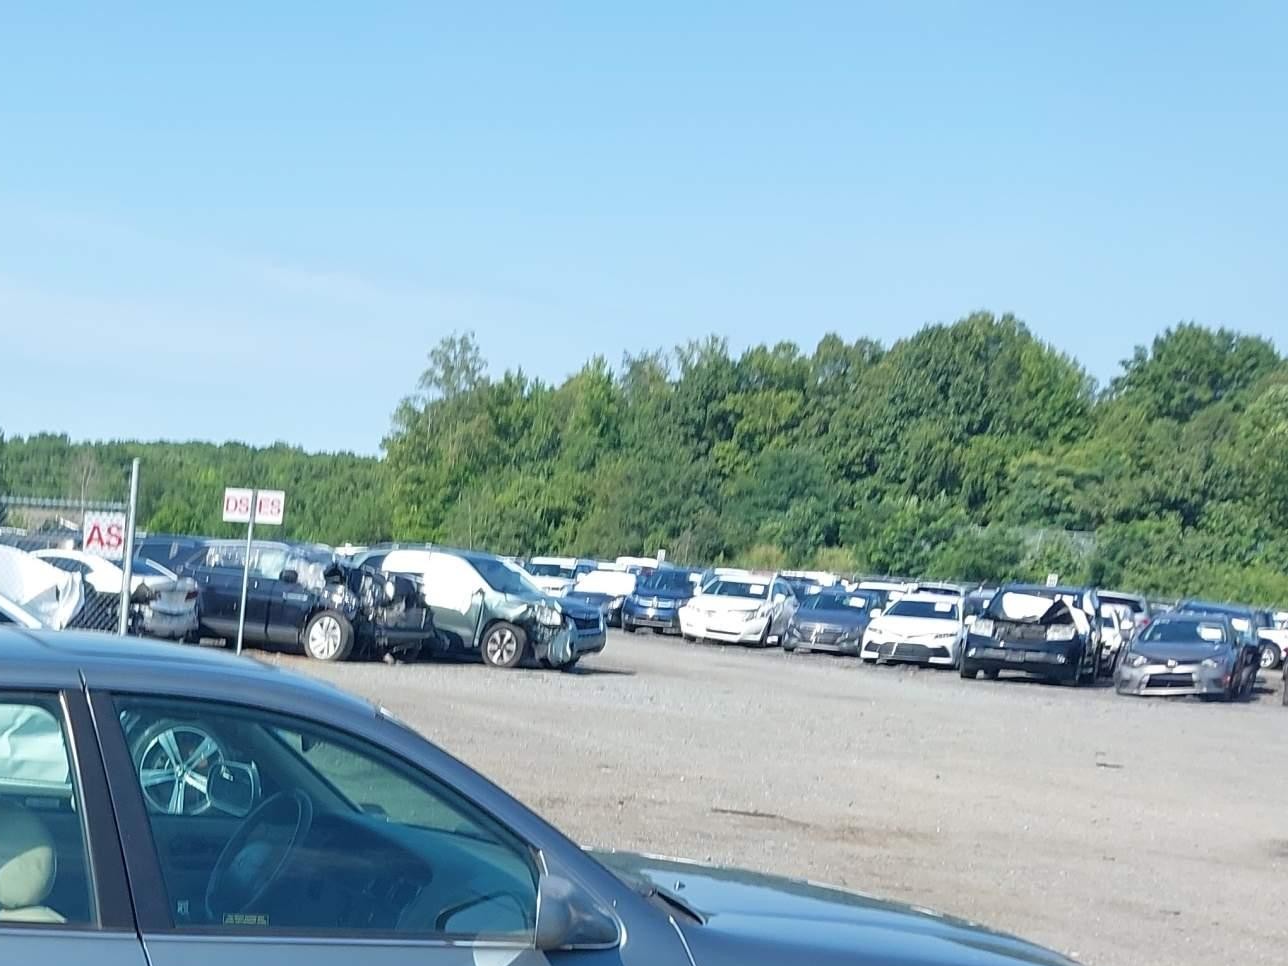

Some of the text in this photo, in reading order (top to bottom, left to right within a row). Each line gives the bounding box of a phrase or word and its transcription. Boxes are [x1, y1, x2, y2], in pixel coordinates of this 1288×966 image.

[226, 496, 249, 512] DS
[259, 498, 281, 515] ES
[86, 522, 123, 549] AS
